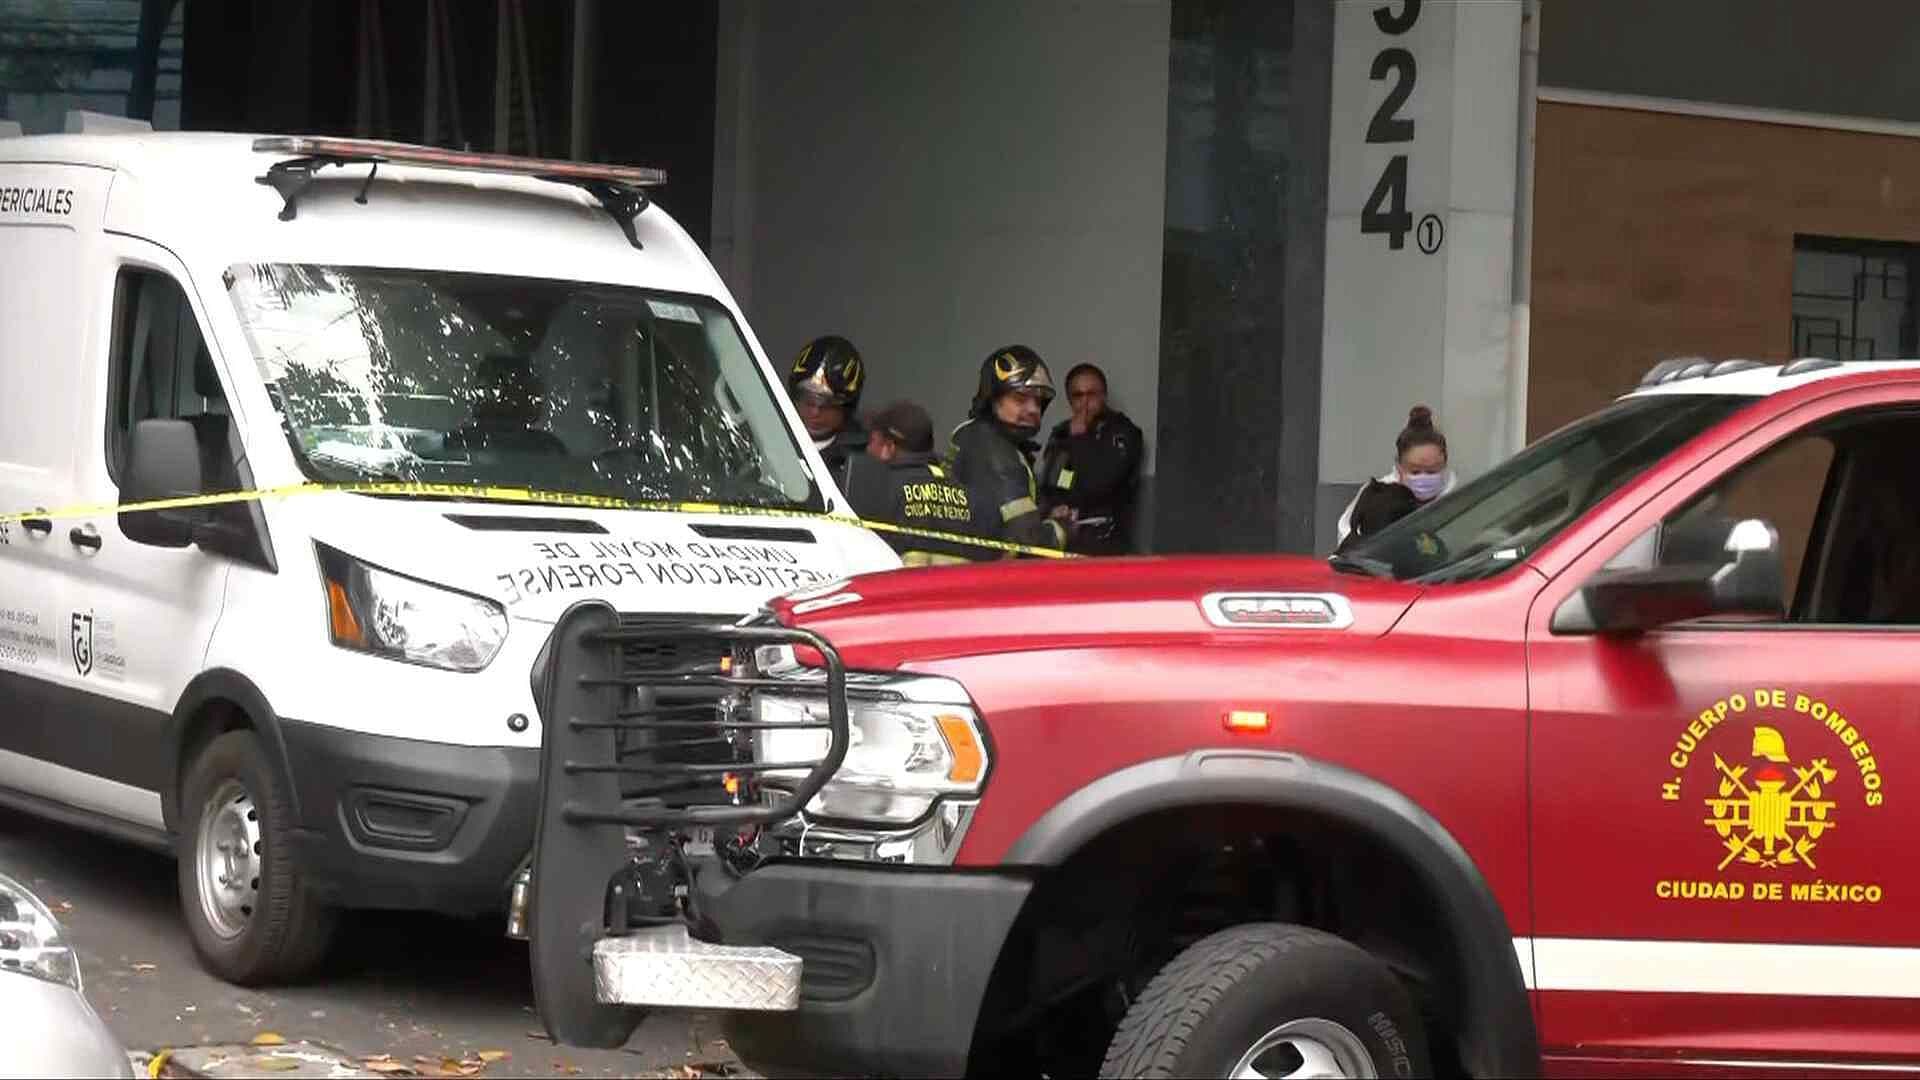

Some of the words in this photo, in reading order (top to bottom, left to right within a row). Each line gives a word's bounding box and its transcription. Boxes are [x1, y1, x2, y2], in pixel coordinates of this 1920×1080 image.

[903, 483, 968, 505] BOMBEROS
[1754, 689, 1787, 708] DE
[1669, 694, 1747, 769] CUERPO
[1794, 694, 1883, 807] BOMBEROS
[1662, 776, 1682, 800] H.
[1656, 881, 1745, 900] CIUDAD
[1753, 882, 1784, 901] DE
[1791, 879, 1882, 902] MÉXICO
